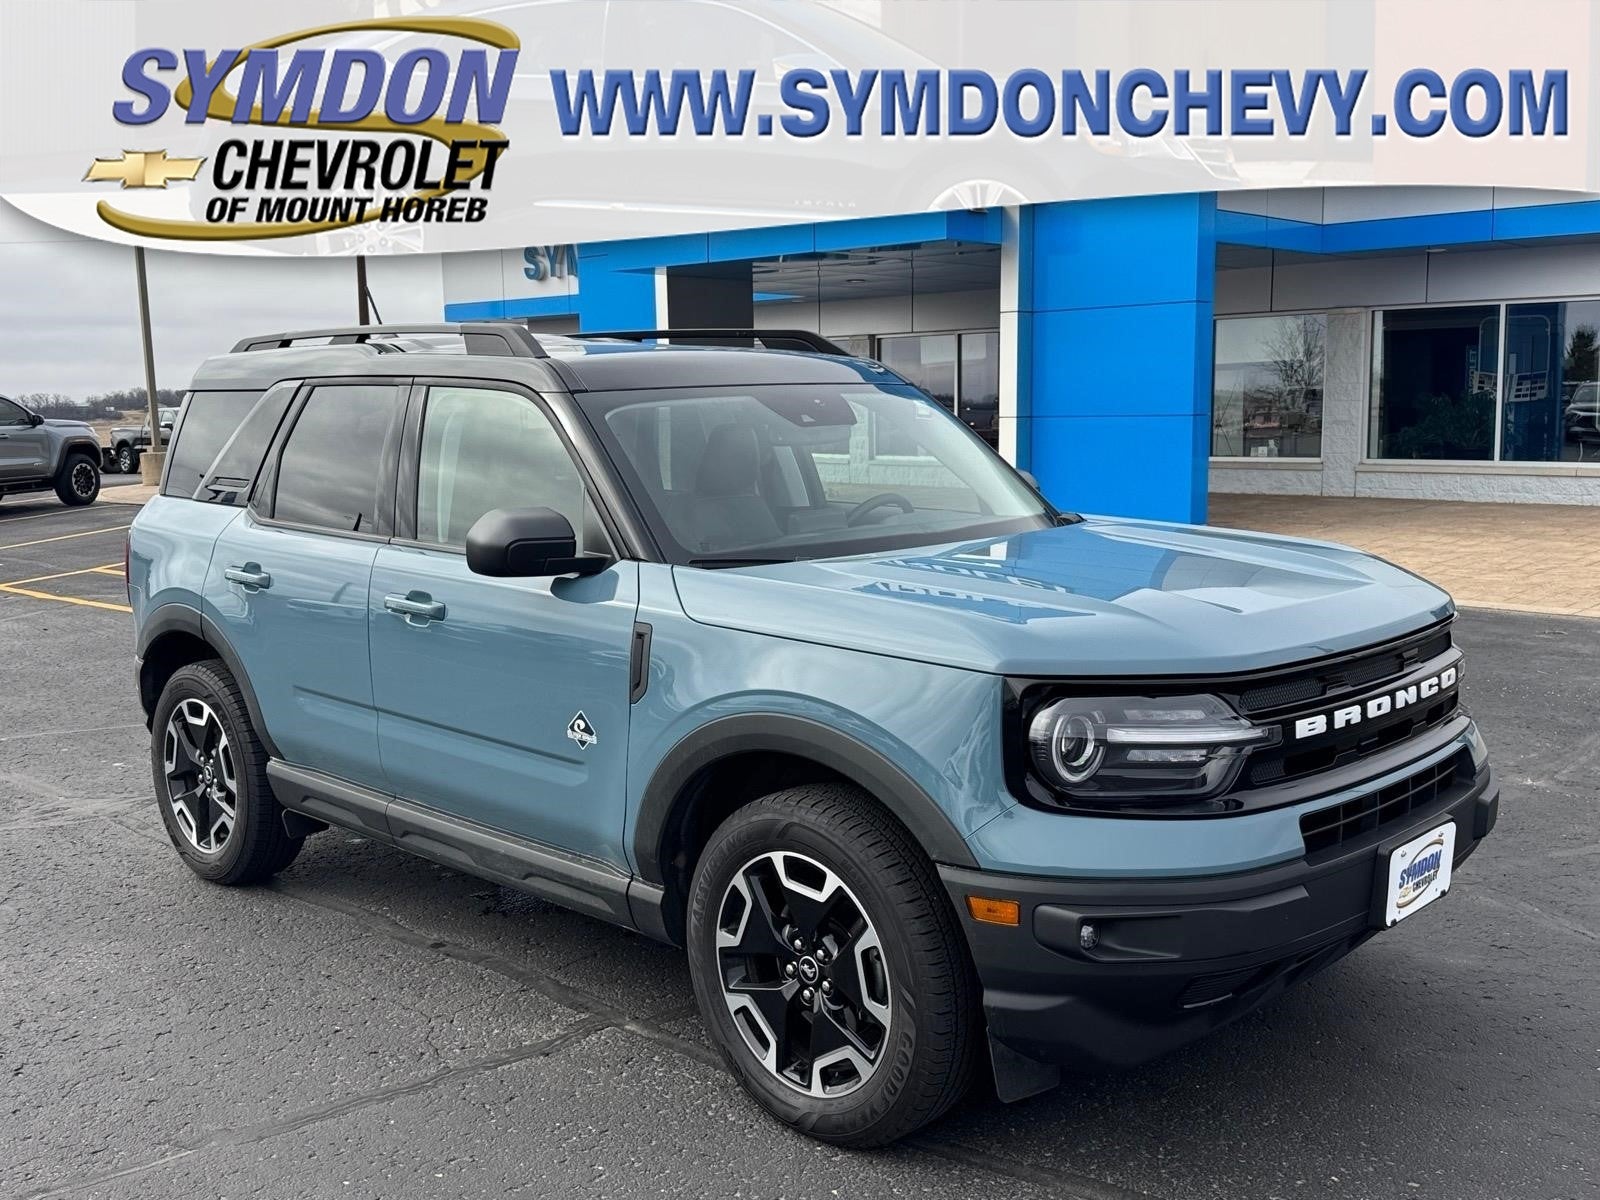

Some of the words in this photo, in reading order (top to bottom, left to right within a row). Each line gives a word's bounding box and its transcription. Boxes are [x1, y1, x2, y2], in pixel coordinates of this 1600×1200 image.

[1295, 667, 1458, 739] BRONCO
[1398, 850, 1442, 889] SYMDON
[1412, 869, 1439, 892] CHEVROLET
